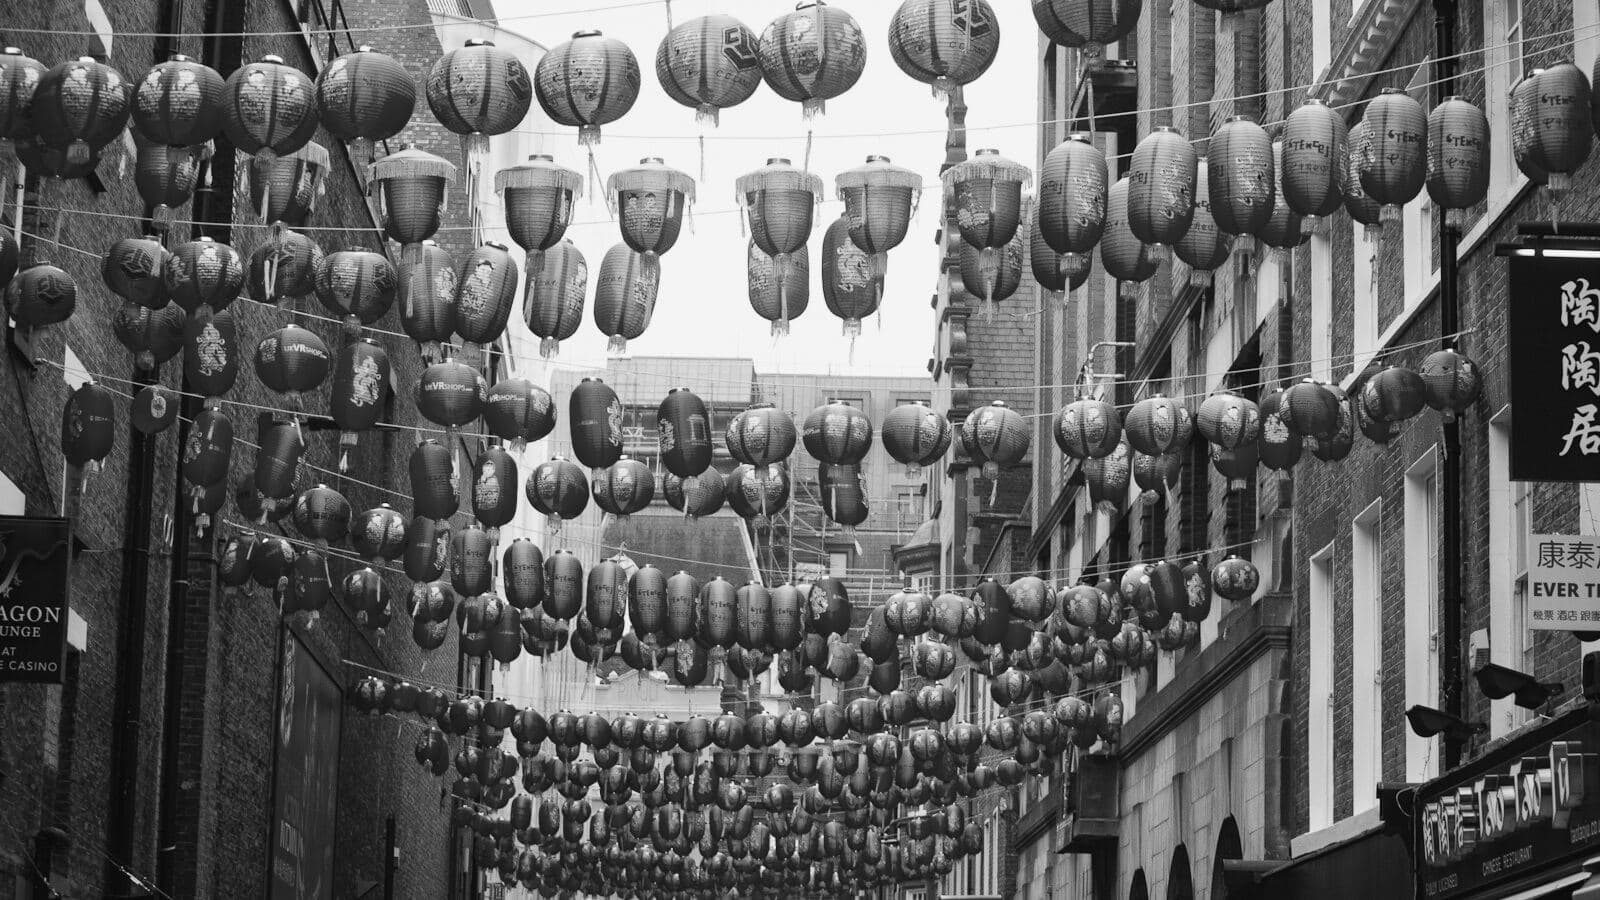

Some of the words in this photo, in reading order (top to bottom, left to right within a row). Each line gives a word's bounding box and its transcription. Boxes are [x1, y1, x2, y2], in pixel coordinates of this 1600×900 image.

[1559, 278, 1600, 456] 陶陶居
[1537, 540, 1600, 569] 康泰
[1533, 582, 1579, 598] EVER
[1584, 583, 1600, 598] T
[1, 646, 17, 657] AT
[9, 660, 58, 673] CASINO
[1482, 856, 1502, 877] CHINESE
[1502, 845, 1533, 869] RESTAURANT
